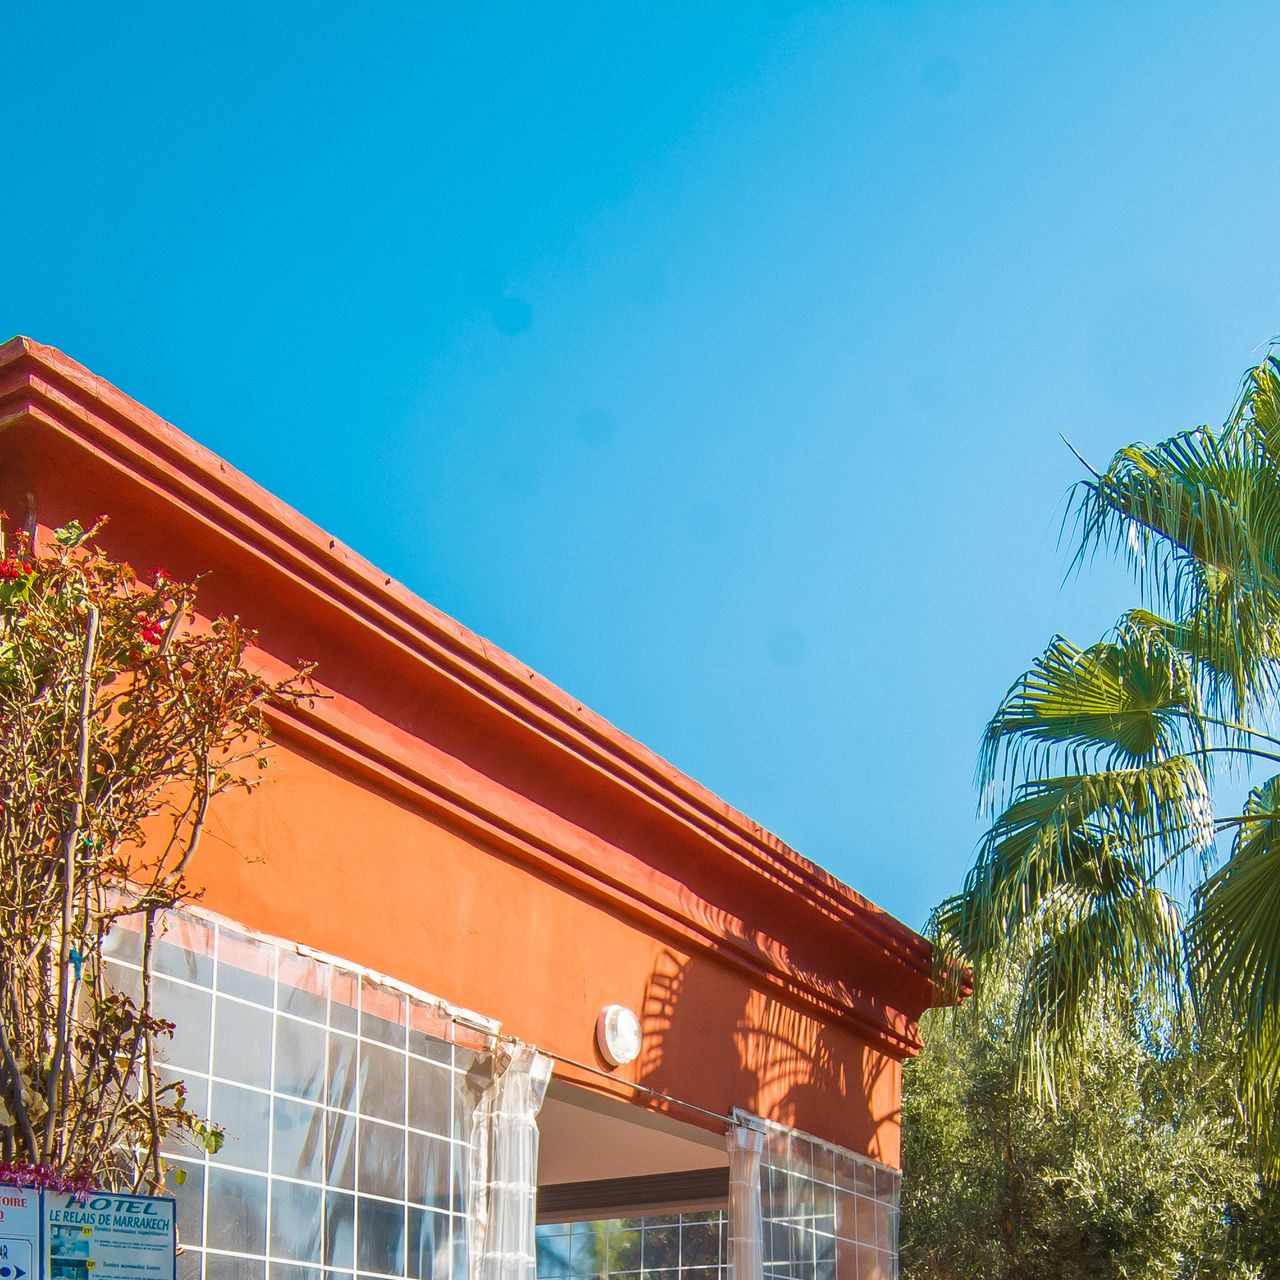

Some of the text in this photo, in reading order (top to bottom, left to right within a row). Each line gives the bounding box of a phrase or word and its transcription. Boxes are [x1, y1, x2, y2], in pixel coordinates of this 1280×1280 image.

[65, 1196, 158, 1215] HOTEL
[50, 1210, 170, 1231] LE RELAIS DE MARRAKECH
